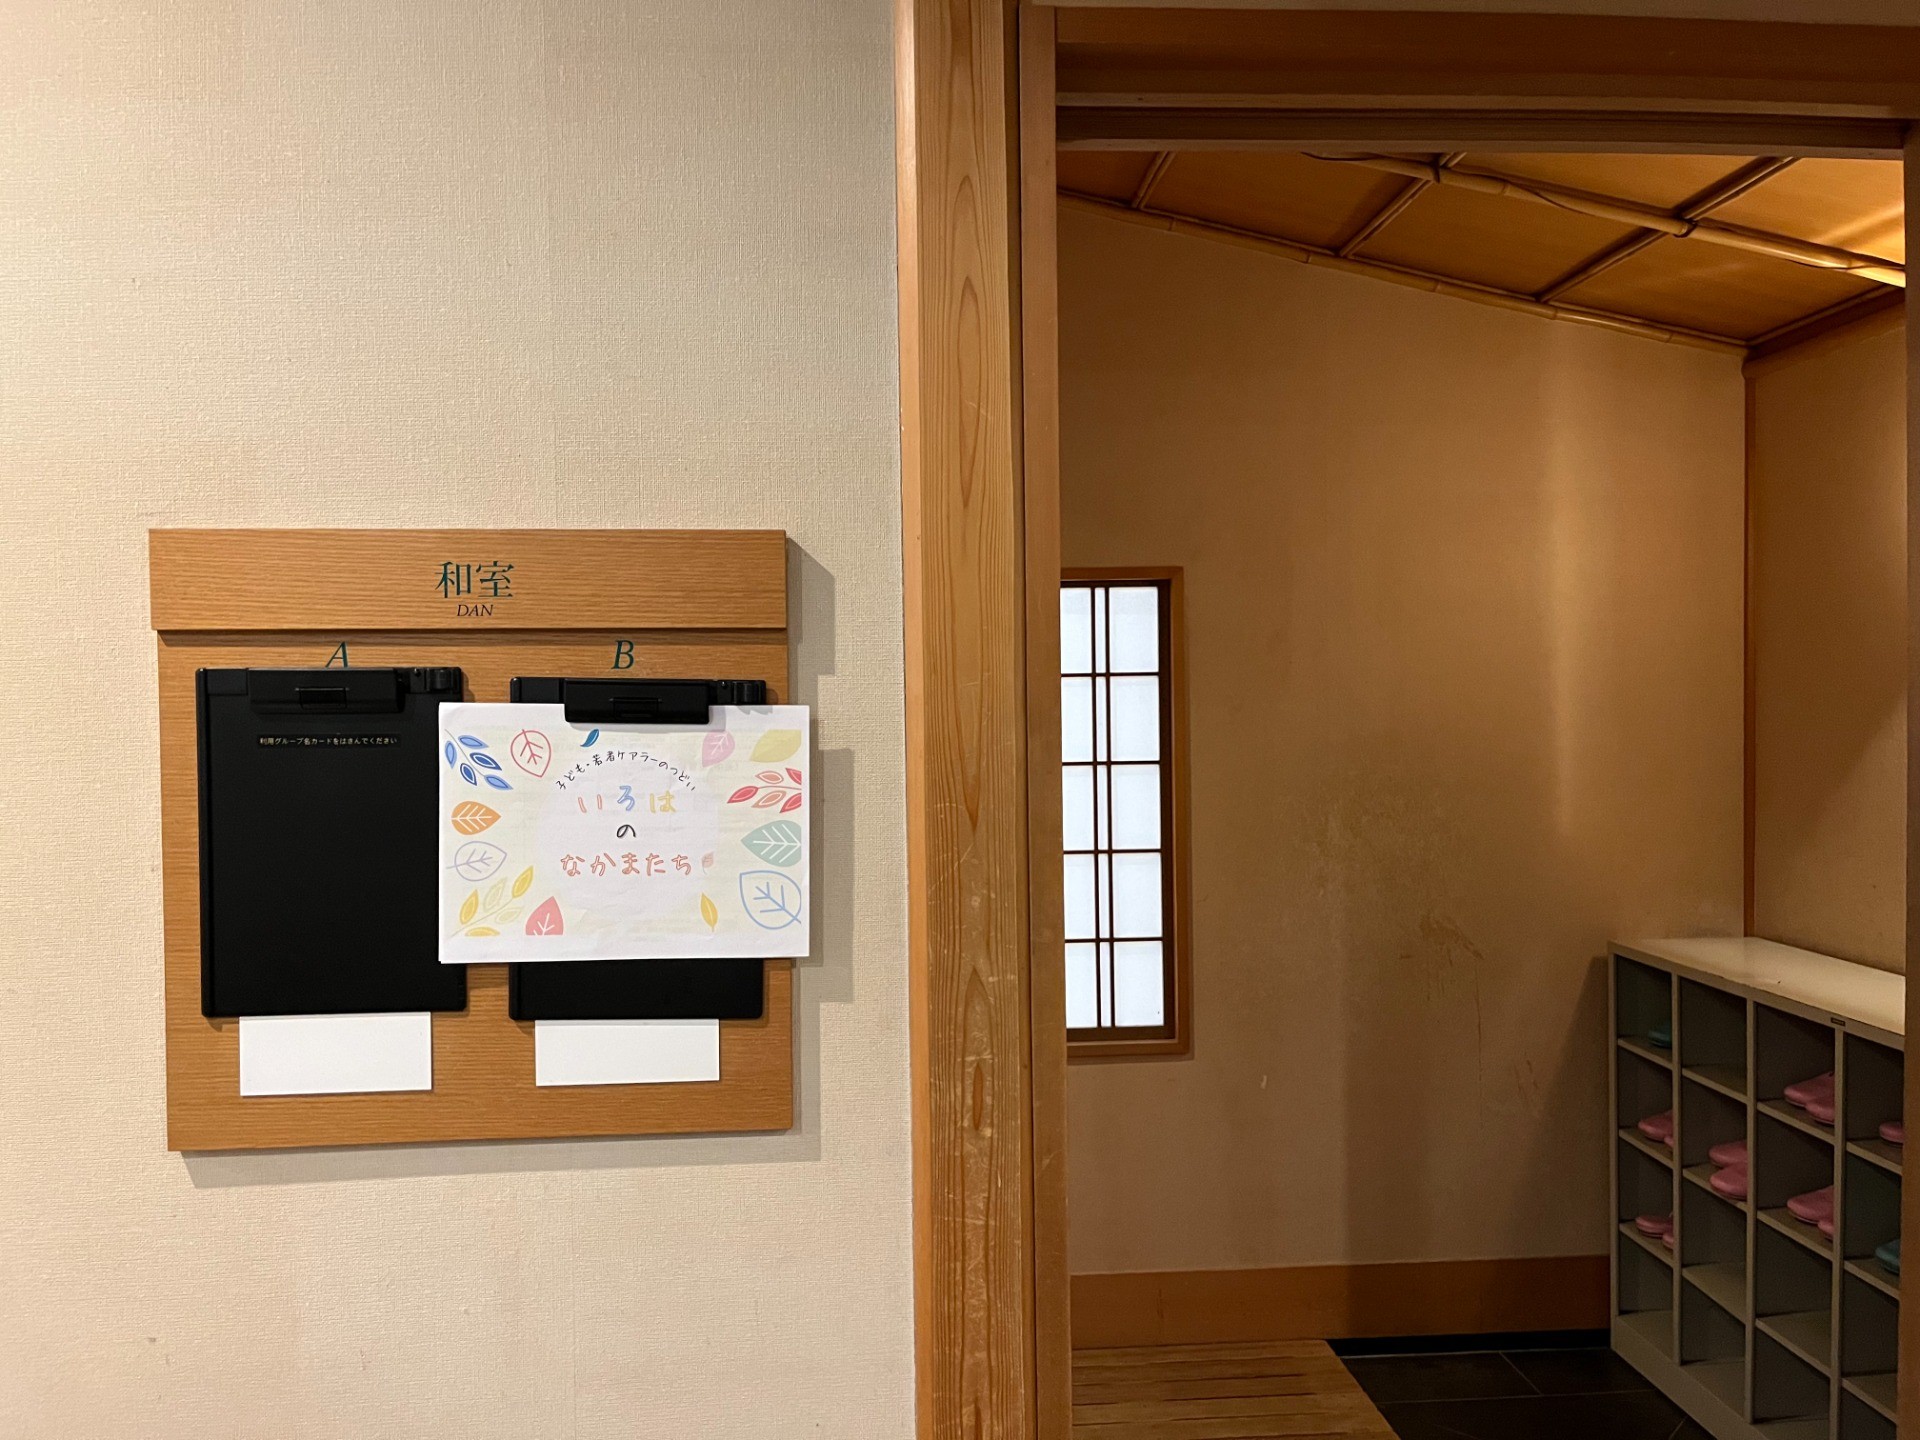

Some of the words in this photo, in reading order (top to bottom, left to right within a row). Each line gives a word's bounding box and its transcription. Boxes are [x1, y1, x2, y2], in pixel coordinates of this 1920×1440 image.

[435, 561, 515, 599] 和室
[456, 604, 494, 617] DAN
[325, 641, 349, 669] A
[611, 640, 635, 670] B
[577, 785, 677, 814] いろは
[616, 824, 637, 839] の
[560, 852, 693, 877] なかまたち
